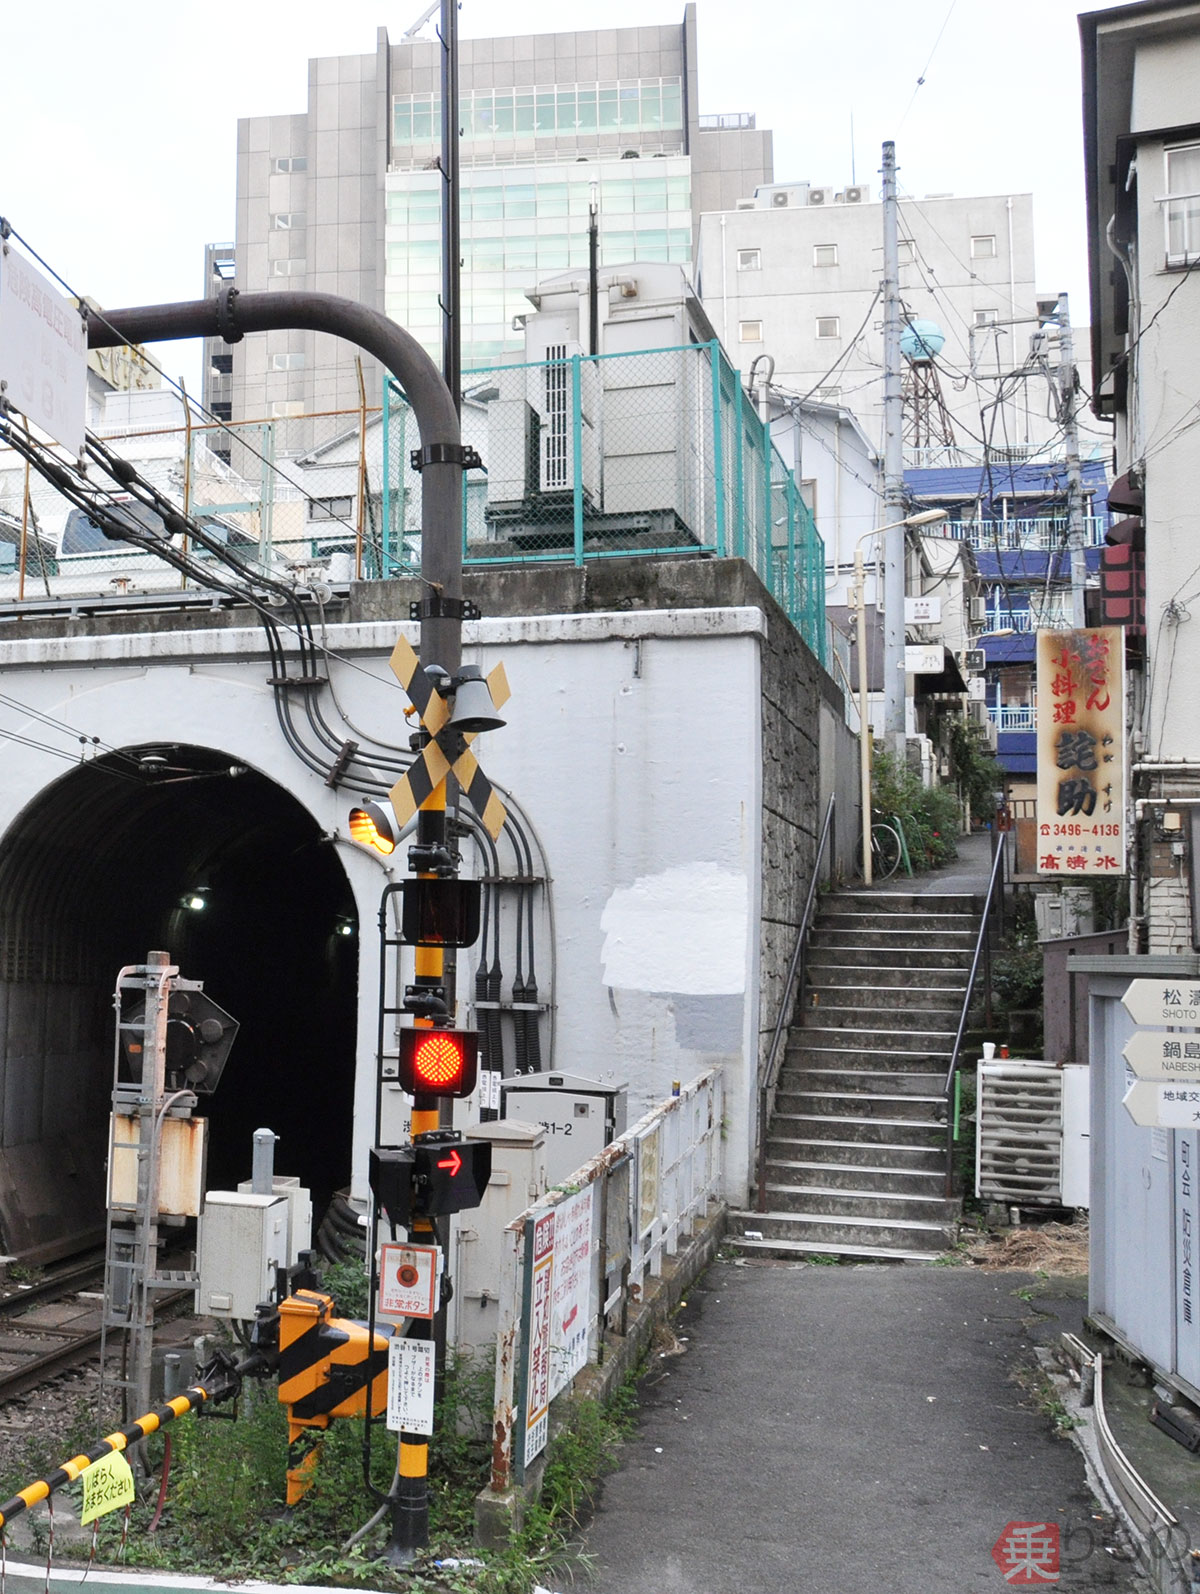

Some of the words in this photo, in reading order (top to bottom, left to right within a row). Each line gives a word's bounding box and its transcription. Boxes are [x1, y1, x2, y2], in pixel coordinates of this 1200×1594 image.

[1051, 649, 1081, 724] 小料理
[1086, 633, 1110, 711] おでん
[1054, 824, 1119, 836] 3496-4136
[1162, 1009, 1197, 1019] SHOTO
[1163, 1041, 1200, 1059] 鍋島
[384, 1298, 428, 1312] 非常ボタン
[530, 1272, 544, 1418] 立入禁止
[86, 1464, 115, 1493] しばらく
[85, 1477, 131, 1513] おまちください
